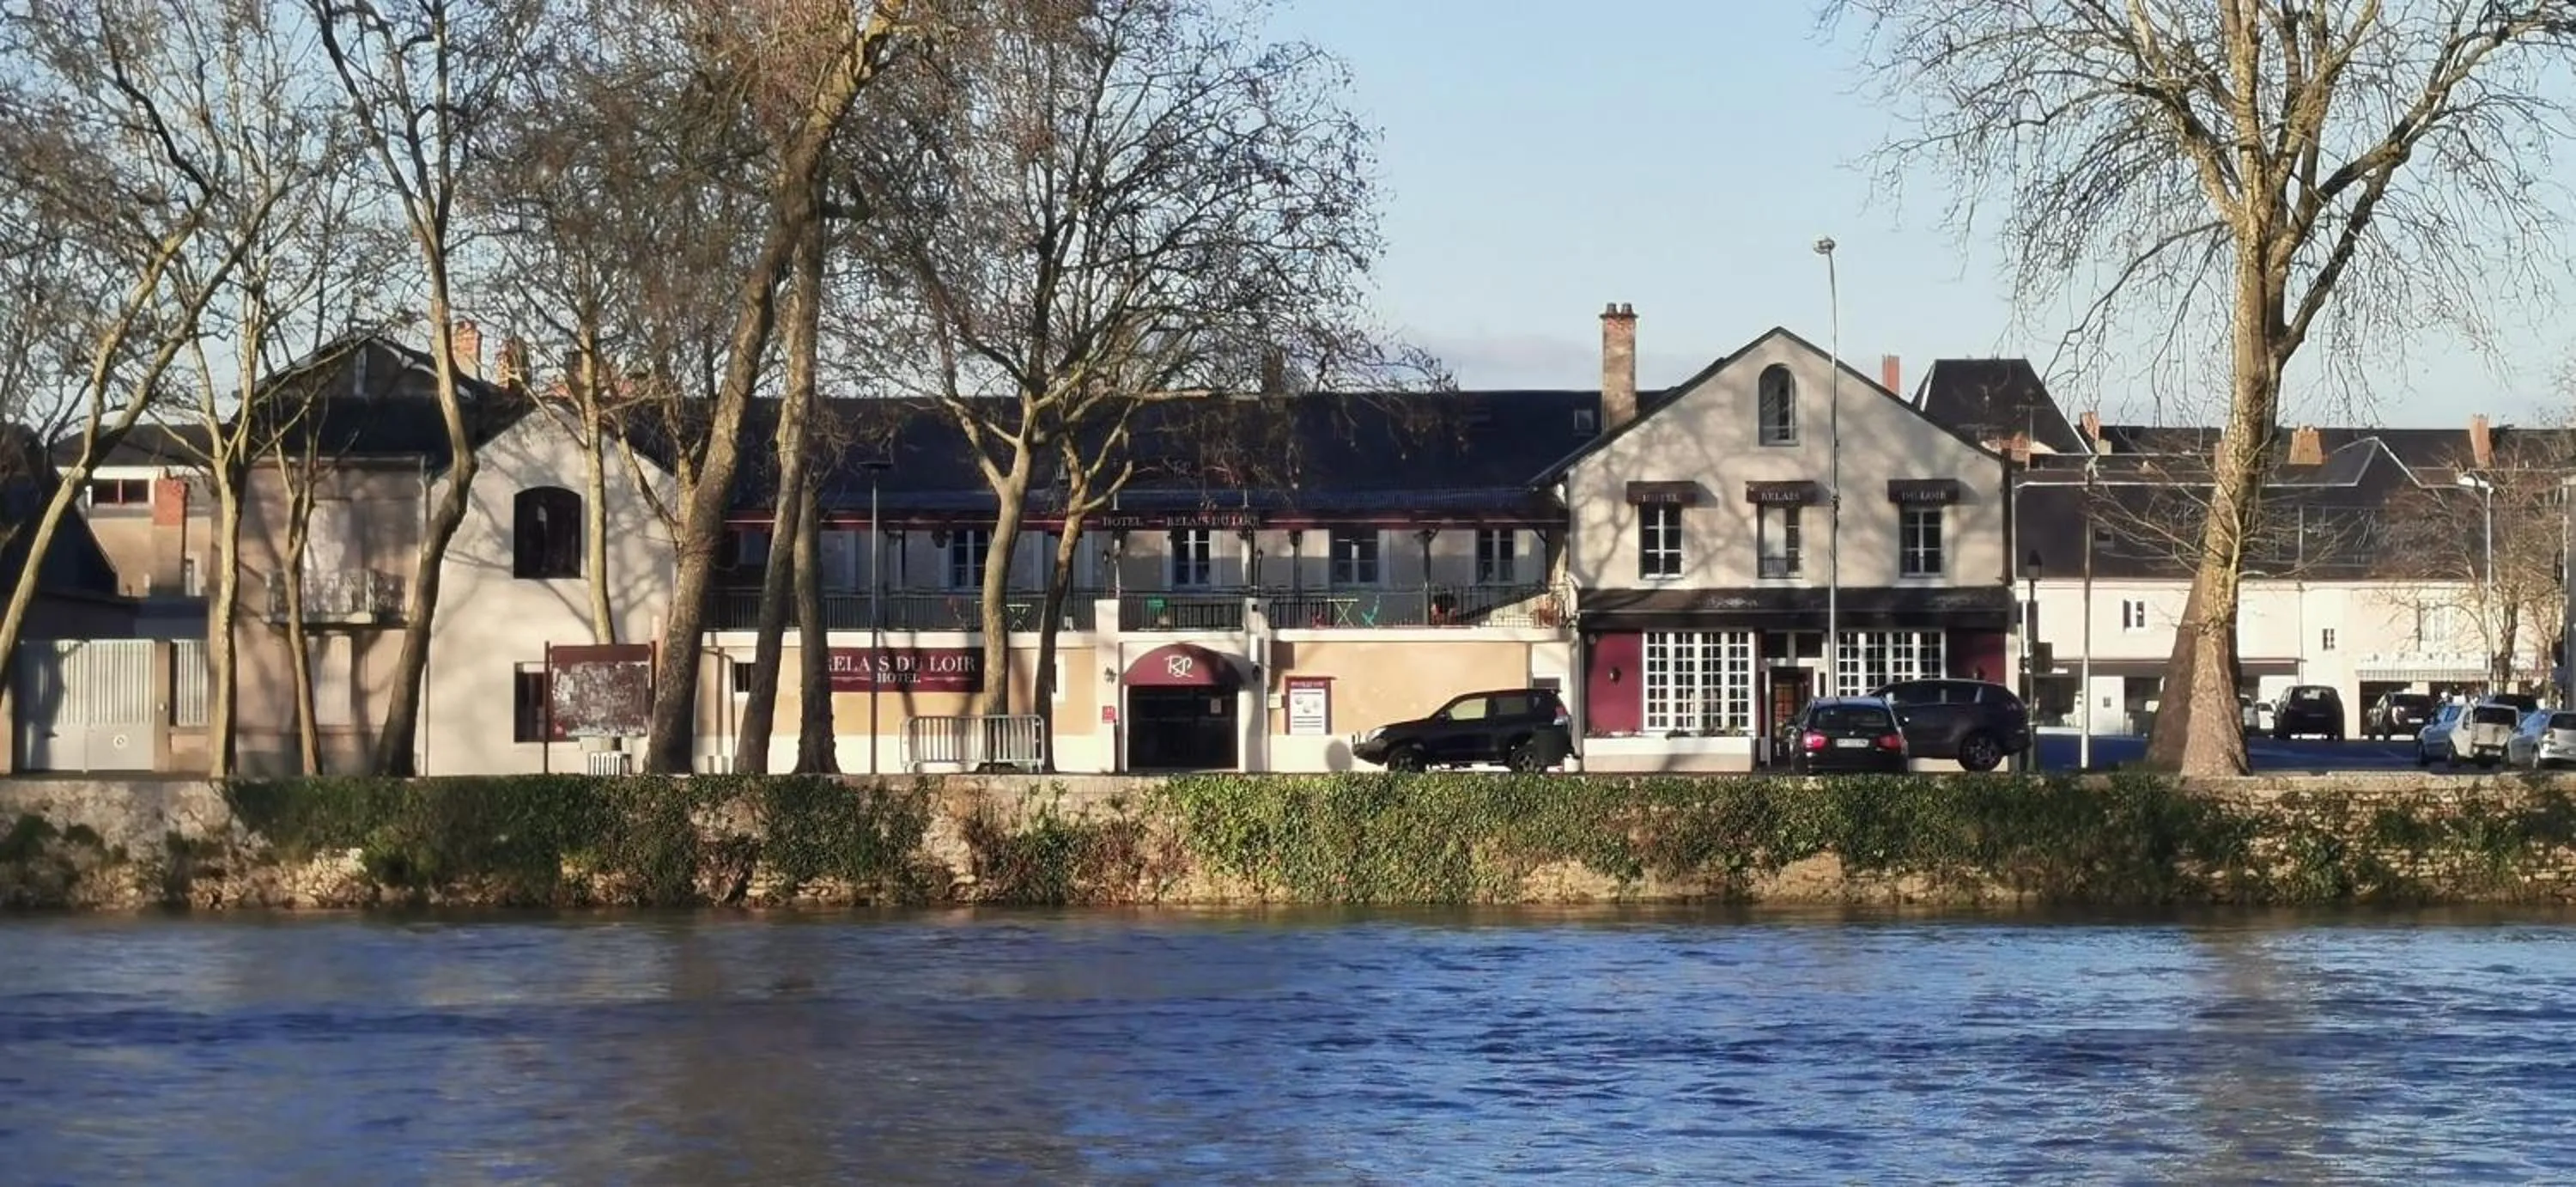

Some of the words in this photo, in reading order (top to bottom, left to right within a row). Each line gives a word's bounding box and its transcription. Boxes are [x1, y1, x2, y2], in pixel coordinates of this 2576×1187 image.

[896, 655, 922, 673] DU
[929, 655, 975, 673] LOIR
[876, 673, 921, 684] HOTEL
